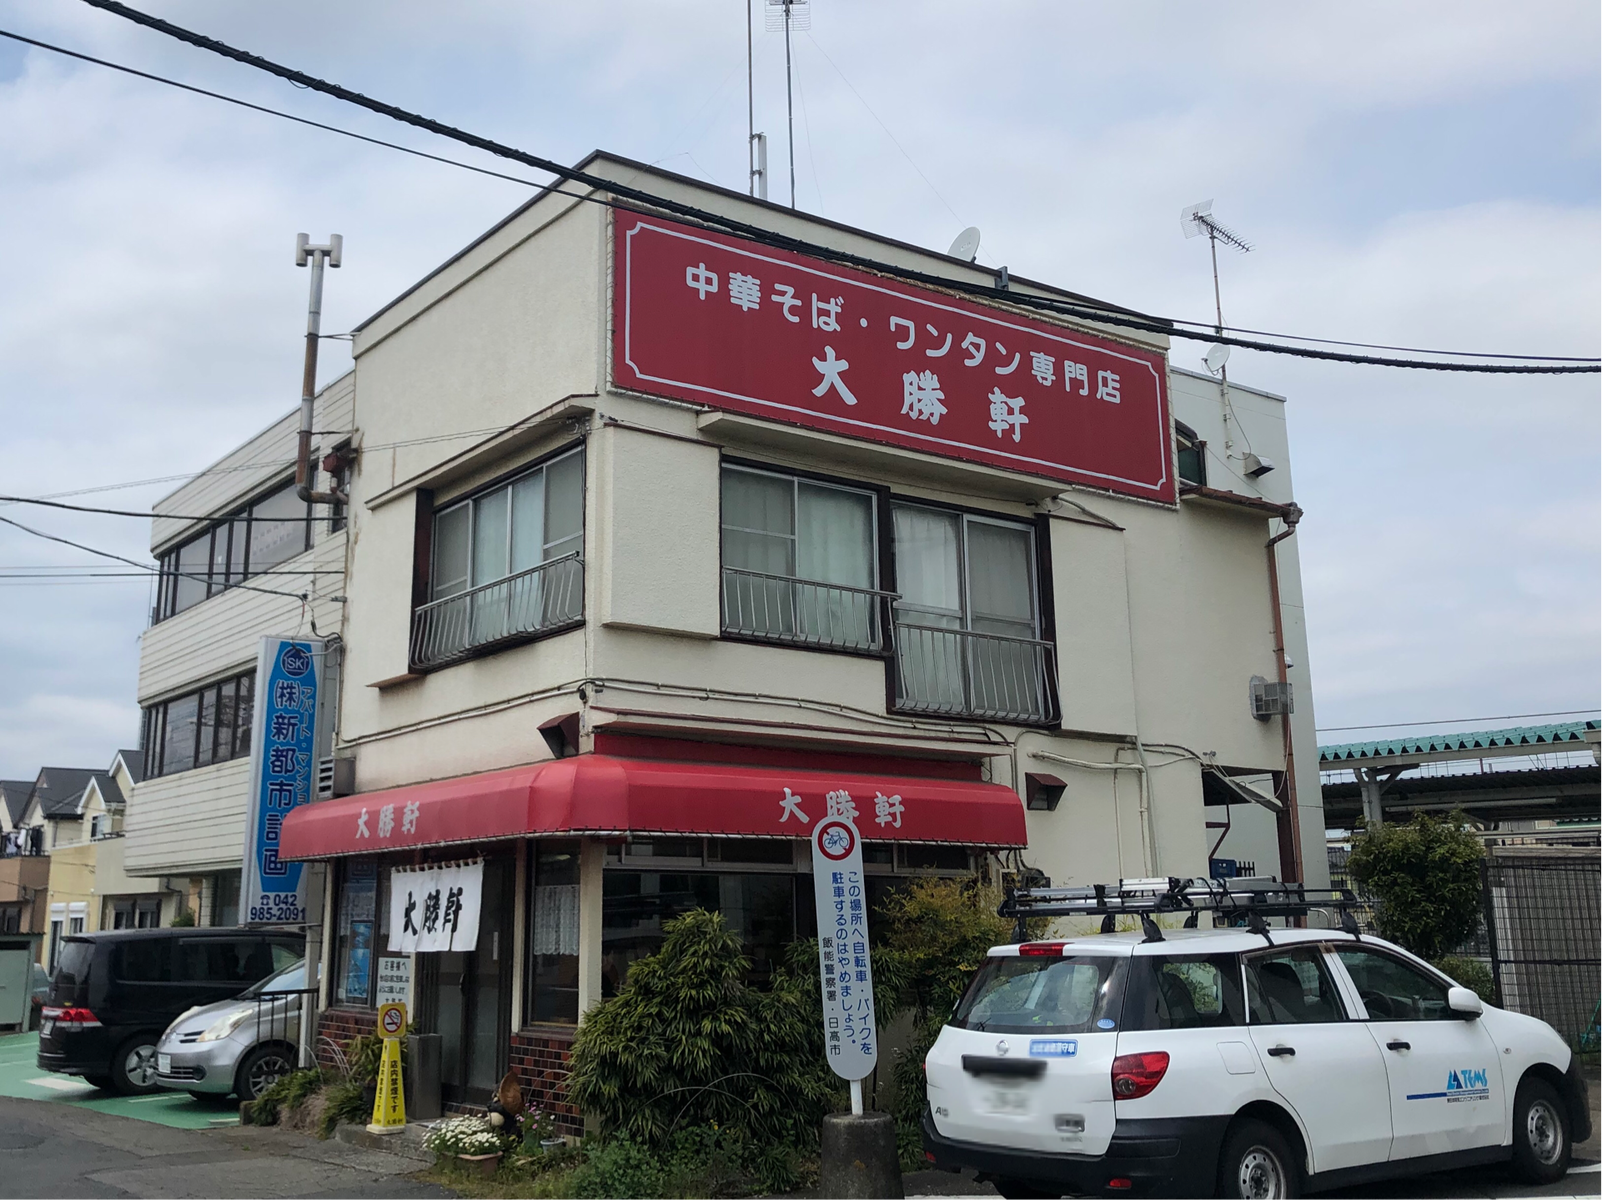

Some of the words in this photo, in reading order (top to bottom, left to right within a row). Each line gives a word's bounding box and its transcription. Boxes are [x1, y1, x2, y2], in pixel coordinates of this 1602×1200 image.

[686, 263, 1121, 404] 中華そば・ワンタン専門店
[812, 345, 1029, 443] 大勝軒
[286, 657, 304, 670] SK
[355, 801, 420, 838] 大勝軒
[779, 787, 905, 829] 大勝軒
[250, 907, 306, 921] 985-2091
[273, 894, 297, 907] 042
[403, 886, 463, 936] 大勝軒
[832, 871, 857, 1045] 駐車するのはやめましょう。
[848, 871, 873, 1055] この場所へ自転車・バイクを
[822, 936, 841, 1056] 飯能警察署・日高市
